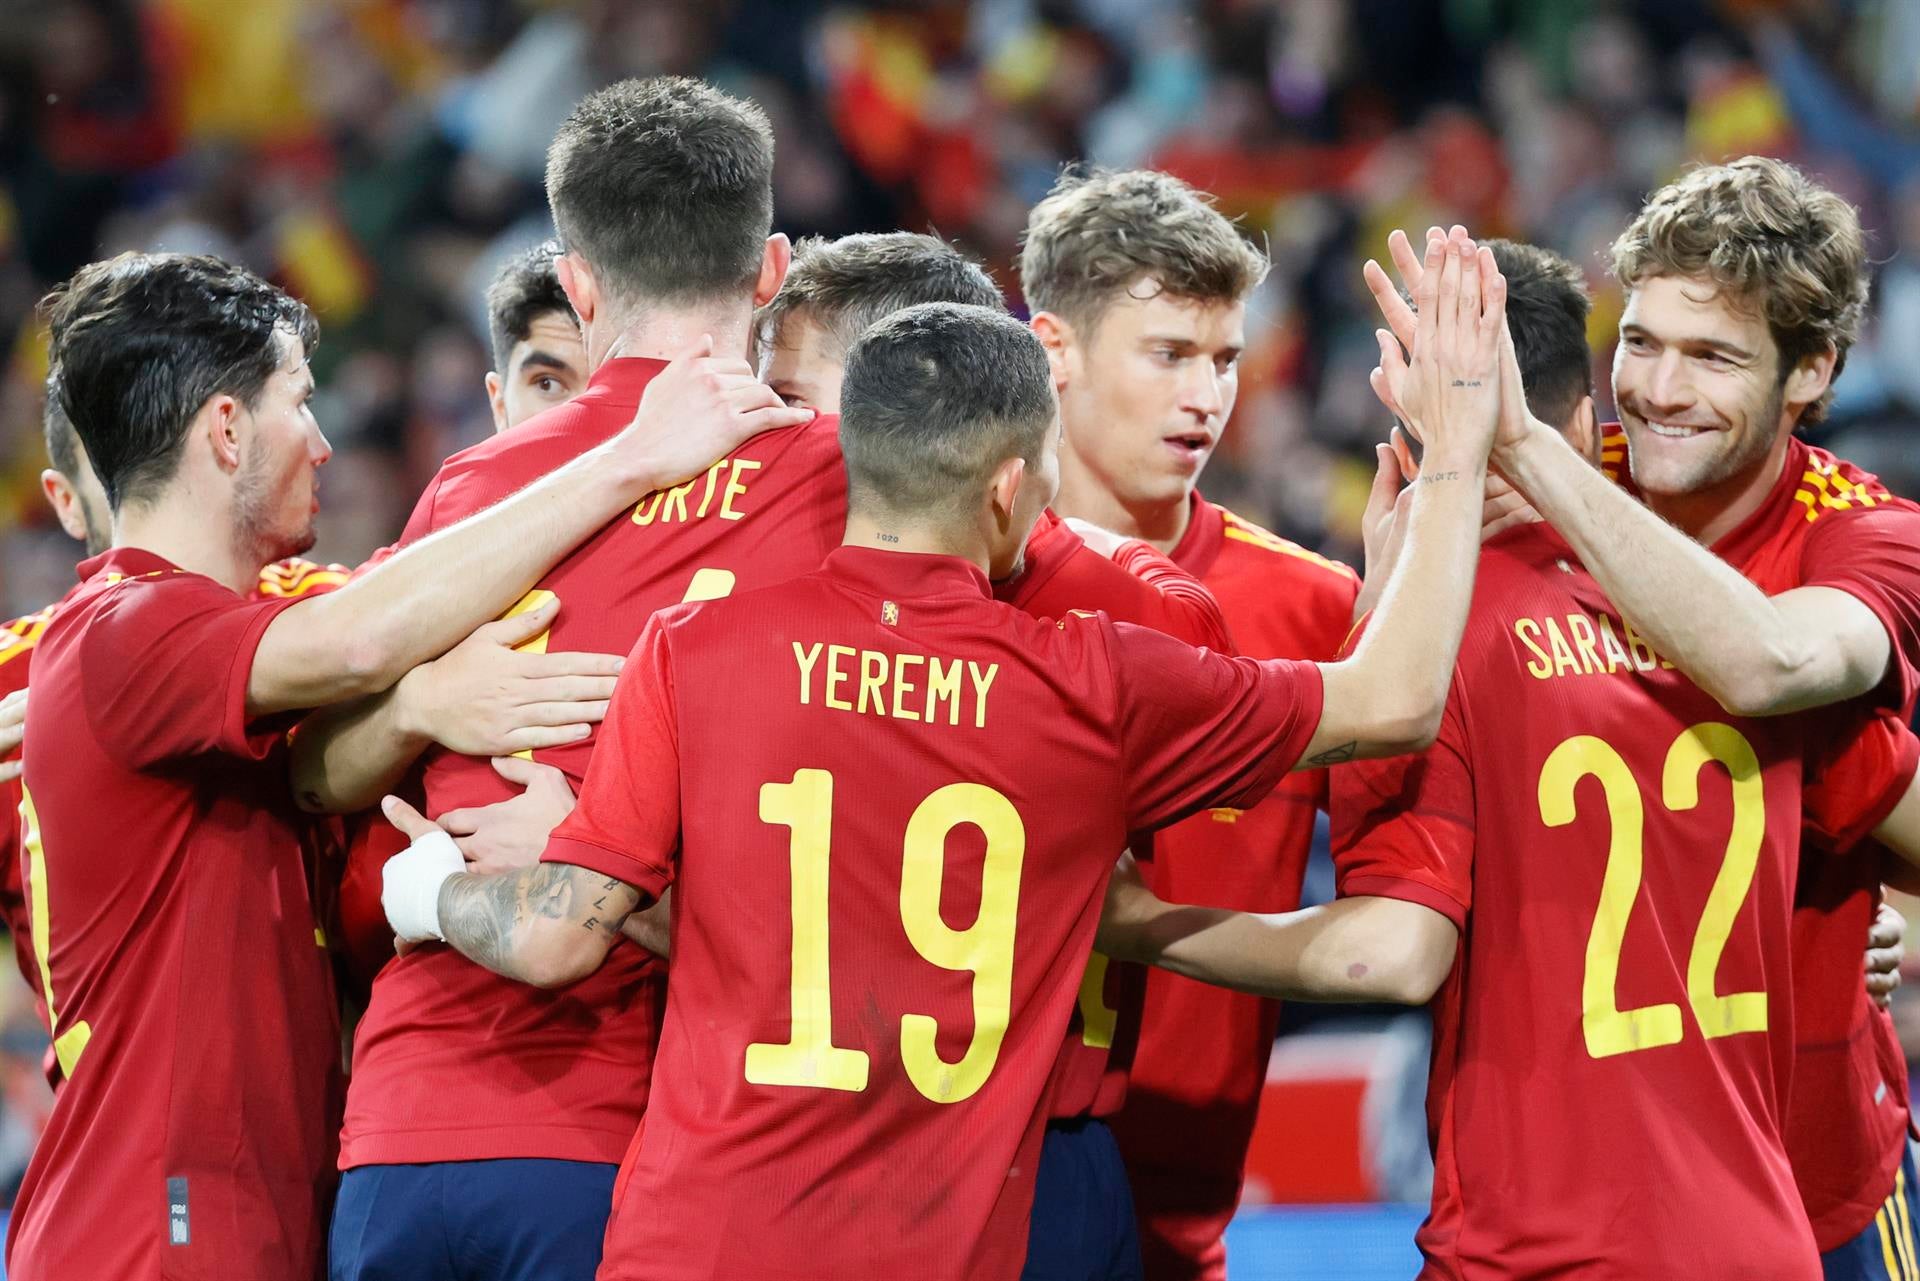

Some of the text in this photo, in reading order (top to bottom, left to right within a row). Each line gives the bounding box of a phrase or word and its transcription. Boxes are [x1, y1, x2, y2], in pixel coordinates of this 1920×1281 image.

[793, 641, 999, 729] YEREMY
[1514, 612, 1676, 680] SARAB
[745, 768, 1027, 1104] 19
[1538, 722, 1766, 1058] 22
